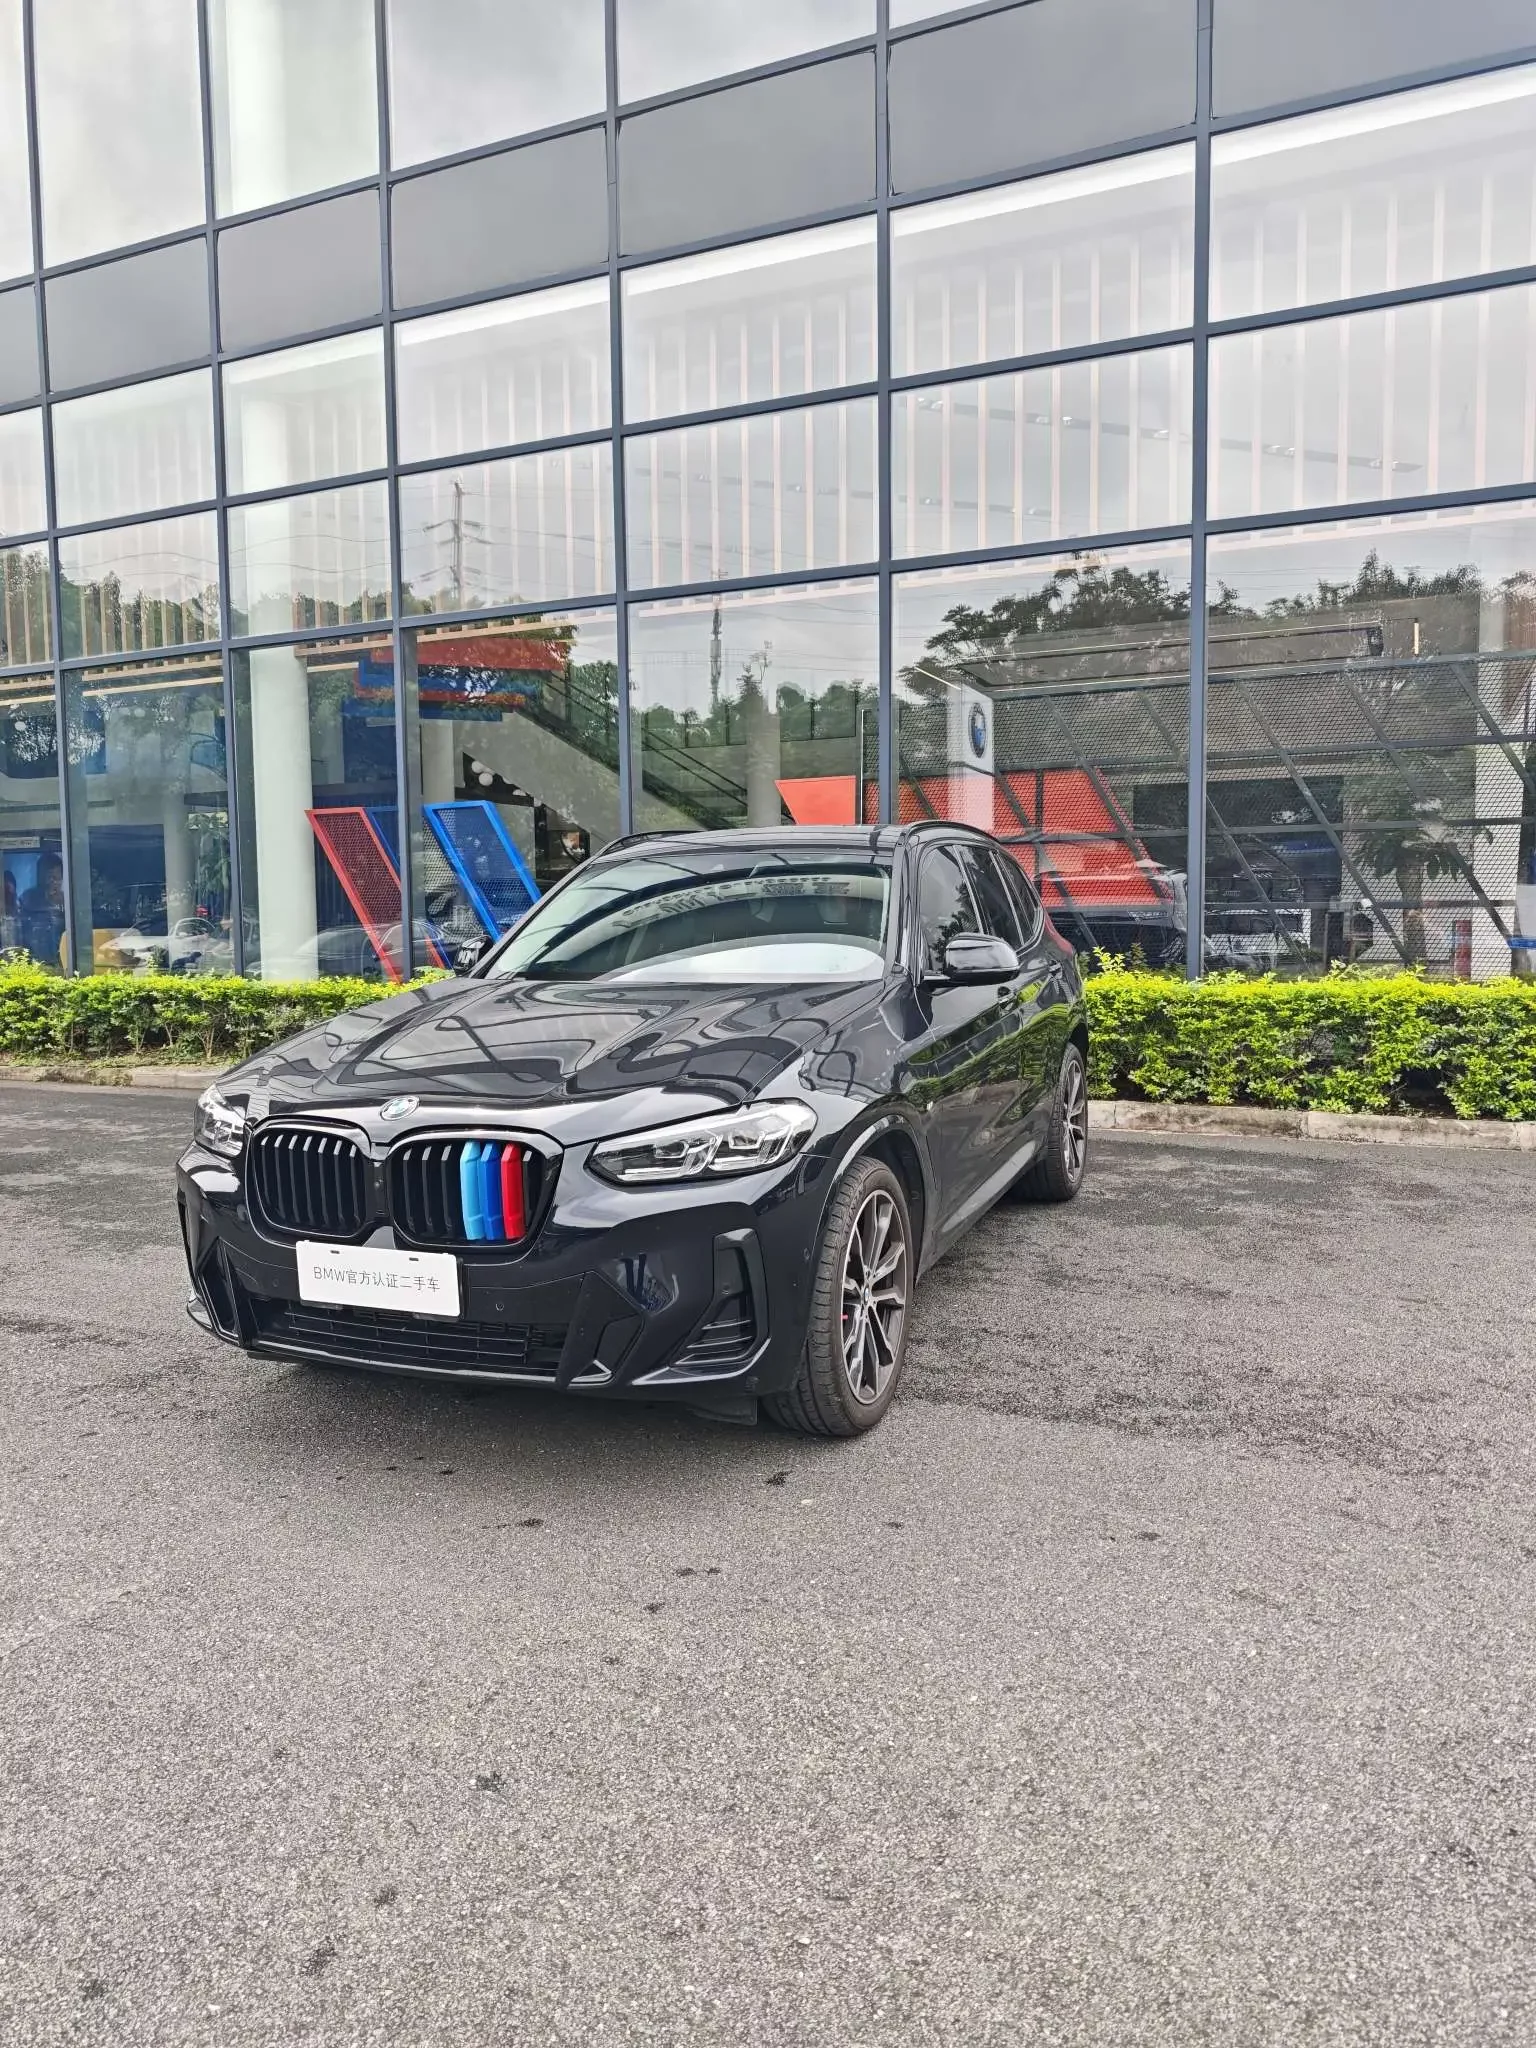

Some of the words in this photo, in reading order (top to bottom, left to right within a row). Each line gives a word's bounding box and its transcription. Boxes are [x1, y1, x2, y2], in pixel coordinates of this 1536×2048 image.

[313, 1266, 440, 1292] BMW官方认证二手车
